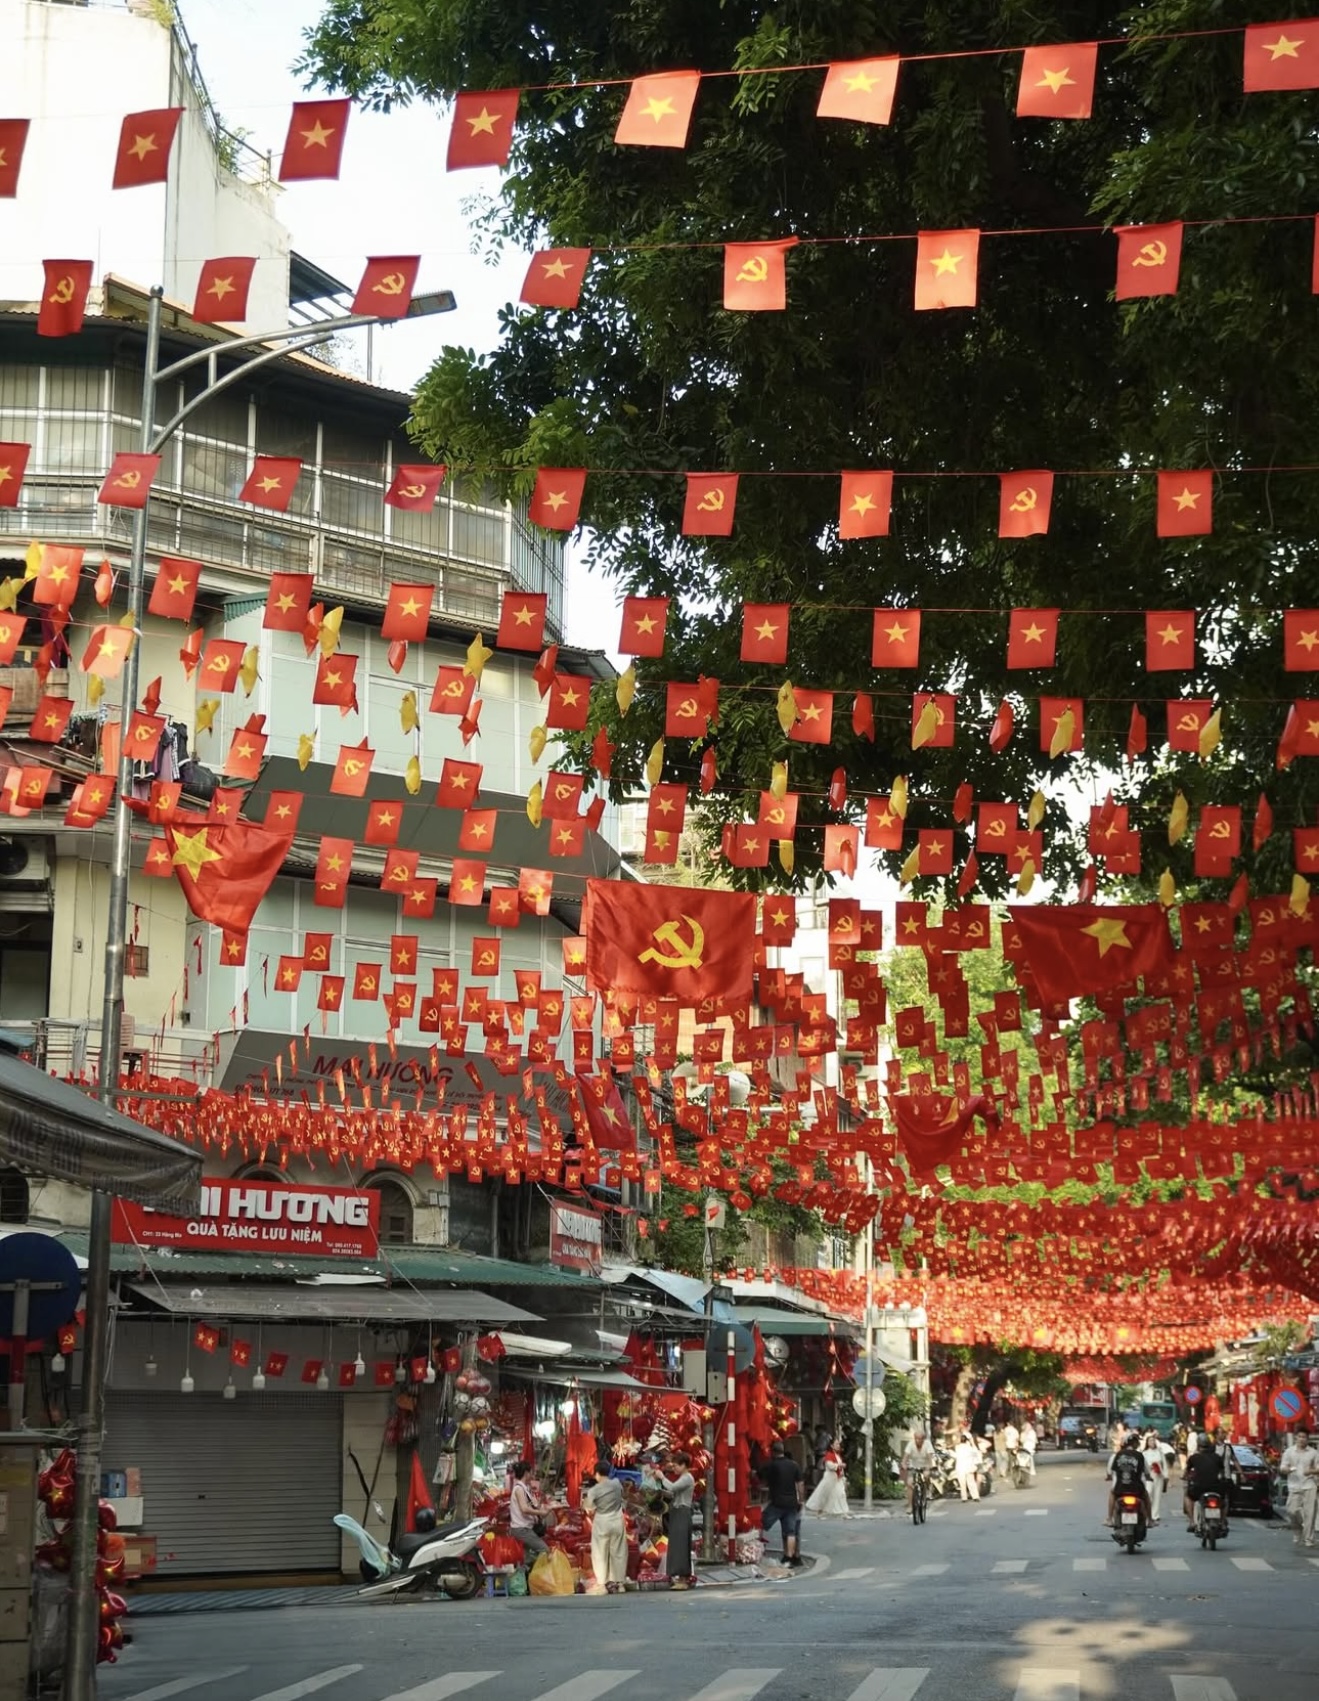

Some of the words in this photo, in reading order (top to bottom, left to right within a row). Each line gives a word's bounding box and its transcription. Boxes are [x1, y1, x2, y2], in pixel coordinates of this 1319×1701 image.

[227, 1187, 369, 1227] HƯƠNG
[186, 1221, 218, 1237] QUÀ
[221, 1223, 258, 1240] TẶNG
[262, 1226, 288, 1241] LƯU
[291, 1226, 323, 1244] NIỆM
